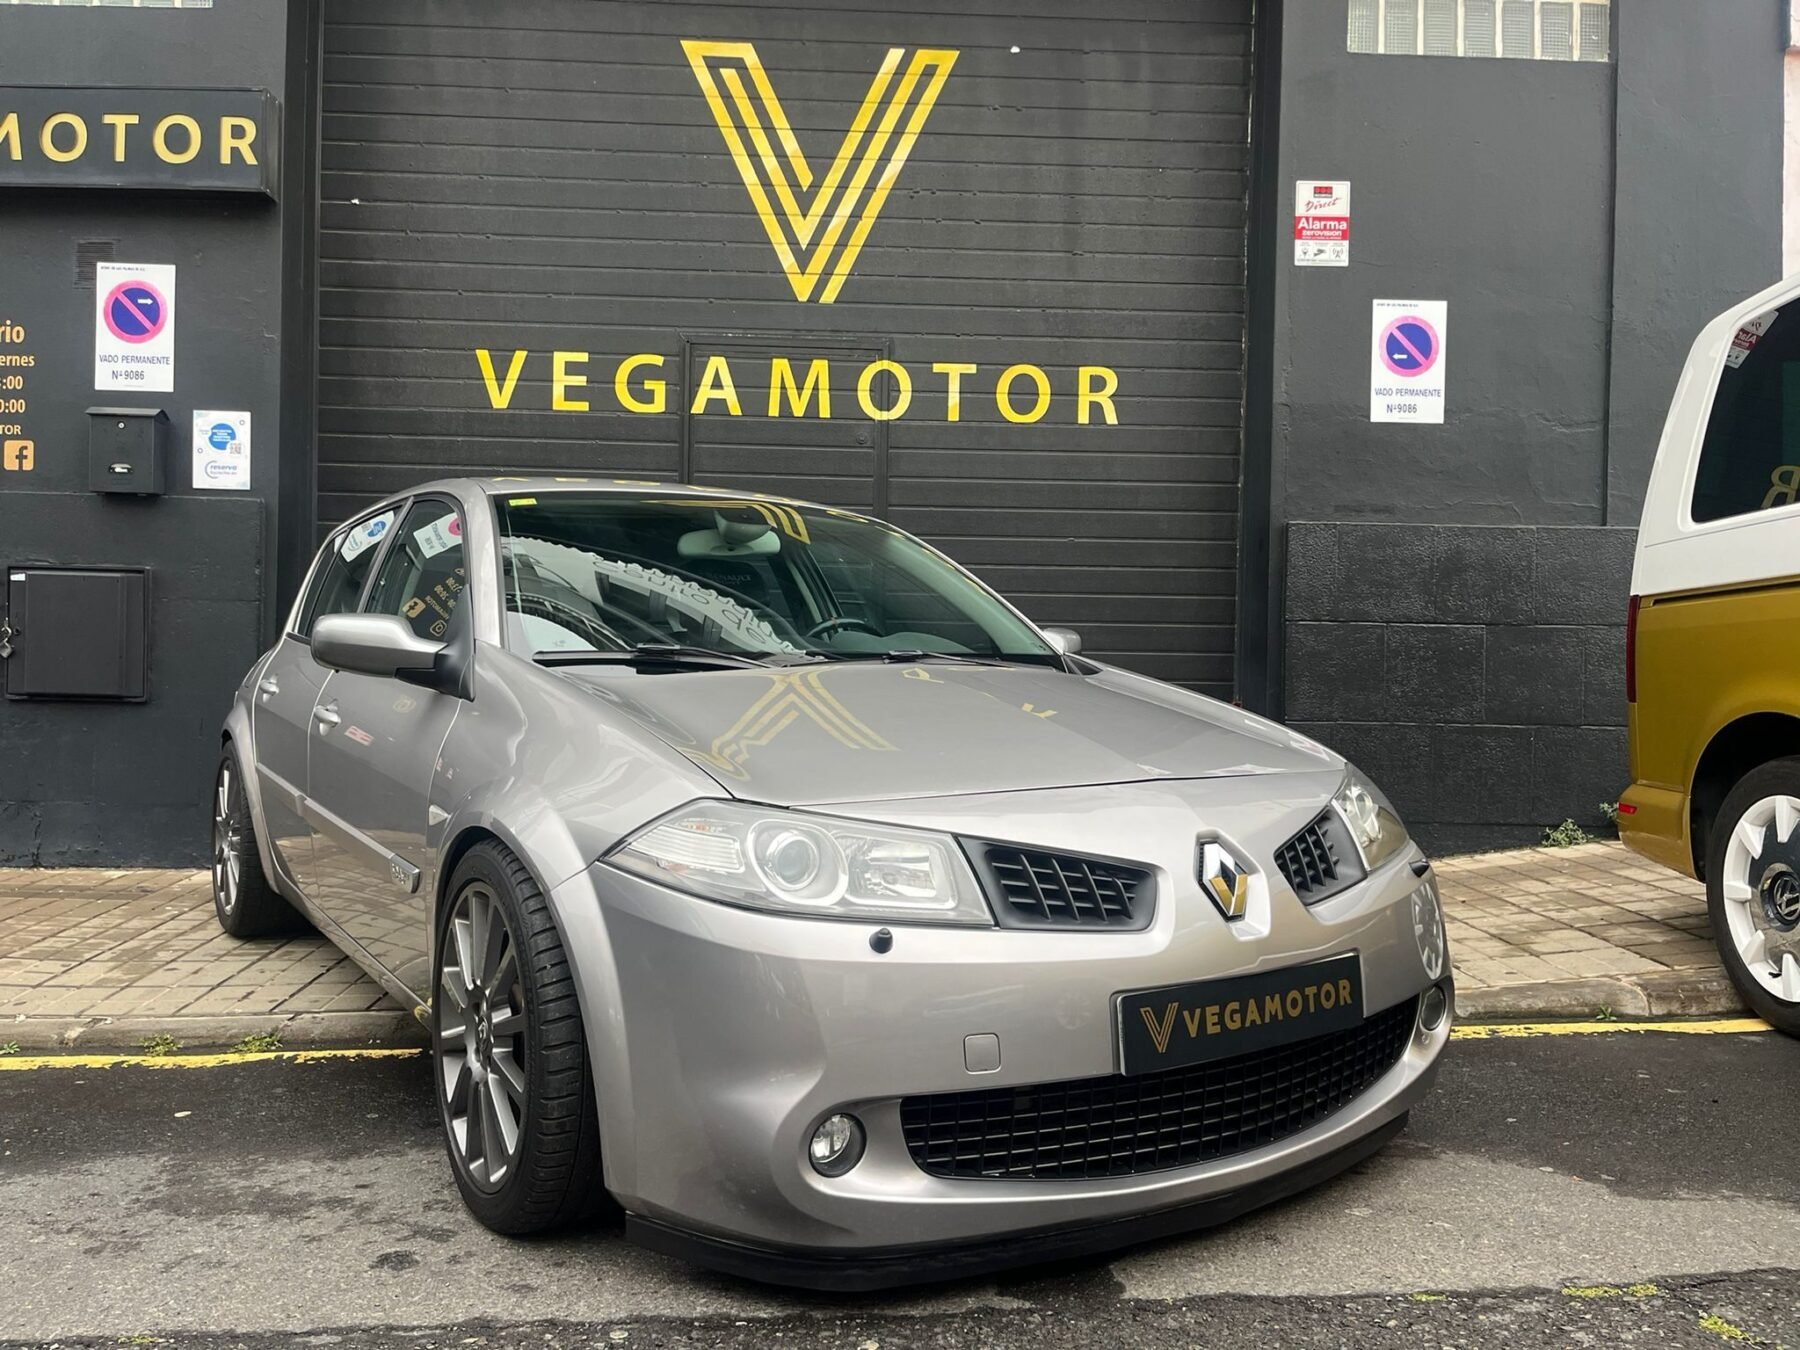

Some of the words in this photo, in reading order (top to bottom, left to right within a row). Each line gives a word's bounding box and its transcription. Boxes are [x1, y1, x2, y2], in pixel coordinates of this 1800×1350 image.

[1297, 217, 1347, 230] Alarma
[98, 354, 119, 363] VADO
[121, 355, 171, 365] PERMANENTE
[475, 349, 1119, 425] VEGAMOTOR
[1374, 387, 1394, 397] VADO
[1395, 388, 1442, 398] PERMANENTE
[1183, 979, 1352, 1038] VEGAMOTOR
